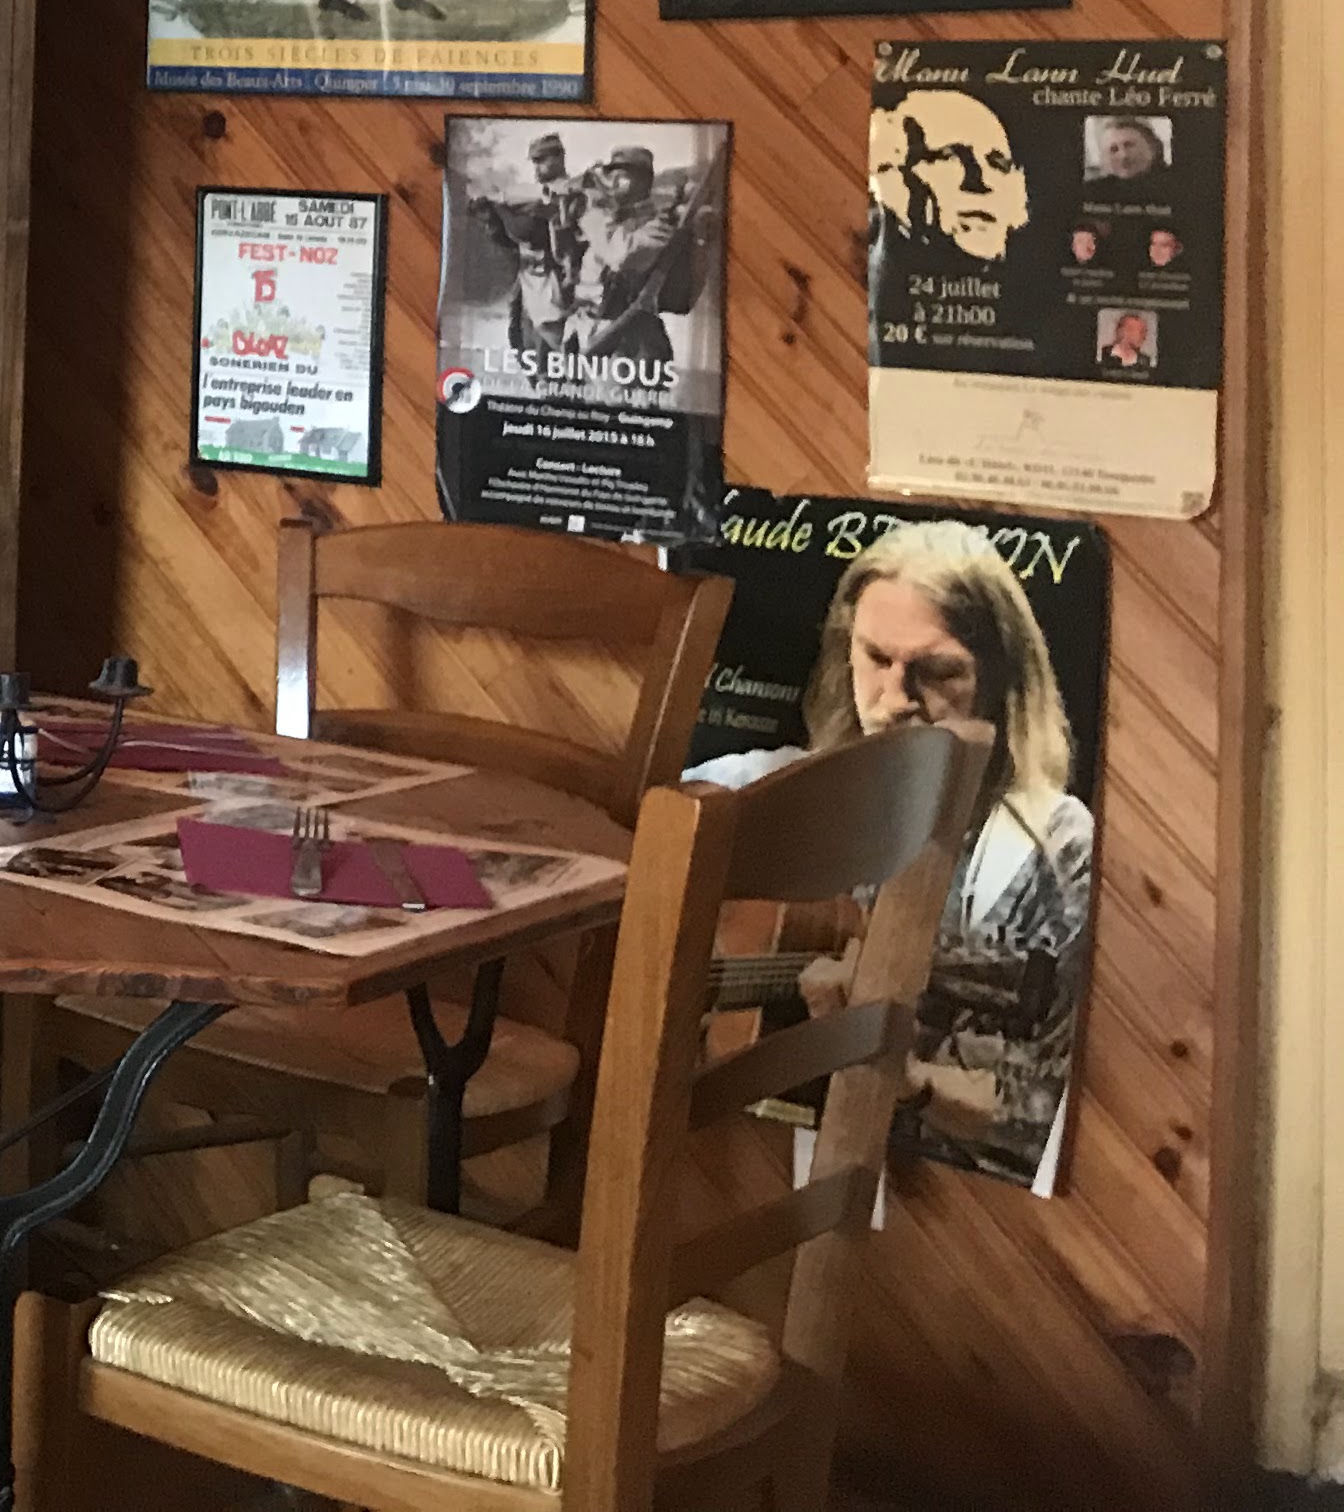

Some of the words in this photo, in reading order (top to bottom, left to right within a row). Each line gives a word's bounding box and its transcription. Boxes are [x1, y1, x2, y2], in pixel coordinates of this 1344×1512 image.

[190, 45, 255, 62] TROIS
[373, 48, 403, 64] DE
[1032, 86, 1102, 107] chante
[1109, 87, 1151, 107] Léo
[298, 199, 355, 214] SAMEDI
[349, 217, 368, 230] 87
[909, 274, 934, 295] 24
[940, 275, 1002, 300] juillet
[931, 303, 996, 327] 21h00
[883, 323, 909, 343] 20
[295, 364, 319, 376] DU
[484, 347, 538, 377] LES
[547, 351, 680, 388] BINIOUS
[203, 394, 236, 410] pays
[240, 394, 306, 416] bigouden
[335, 388, 354, 402] en
